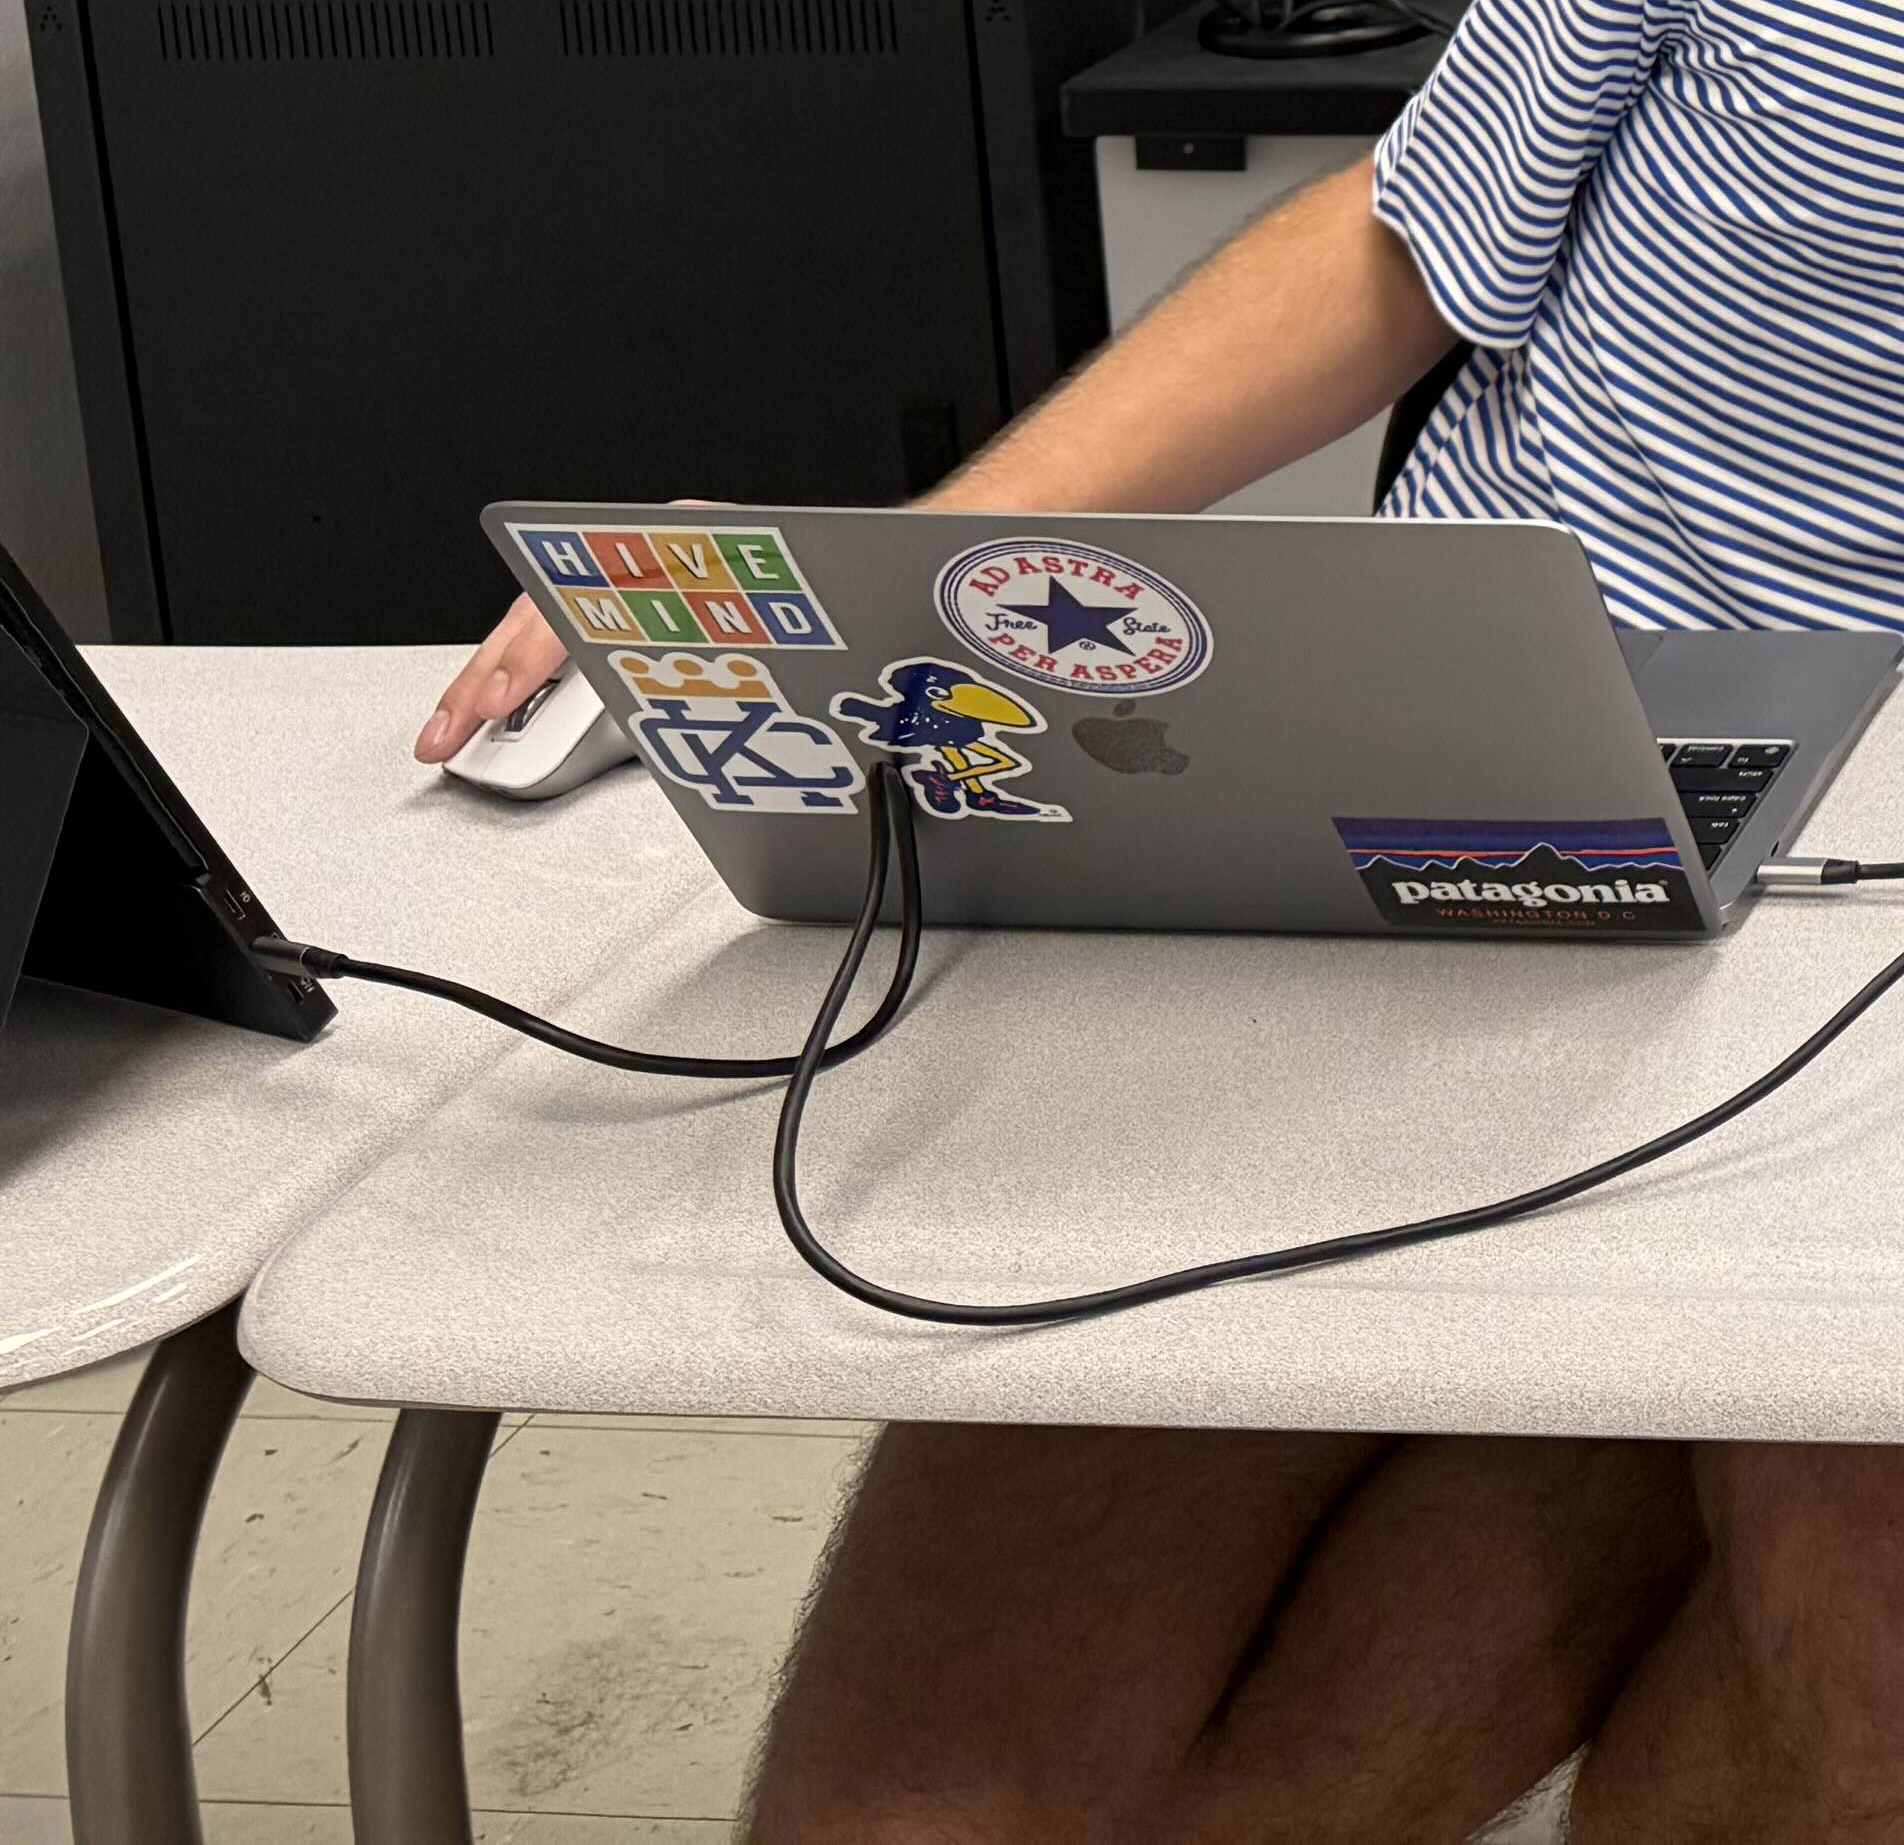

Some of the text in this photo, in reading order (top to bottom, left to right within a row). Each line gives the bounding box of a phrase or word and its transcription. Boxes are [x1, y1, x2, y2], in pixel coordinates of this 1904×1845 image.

[541, 540, 780, 580] HIVE
[968, 556, 1145, 601] AD ASTRA
[574, 596, 813, 635] MIND
[984, 612, 1171, 635] Free State
[987, 633, 1184, 681] PER ASPERA
[1391, 879, 1670, 907] patagonia
